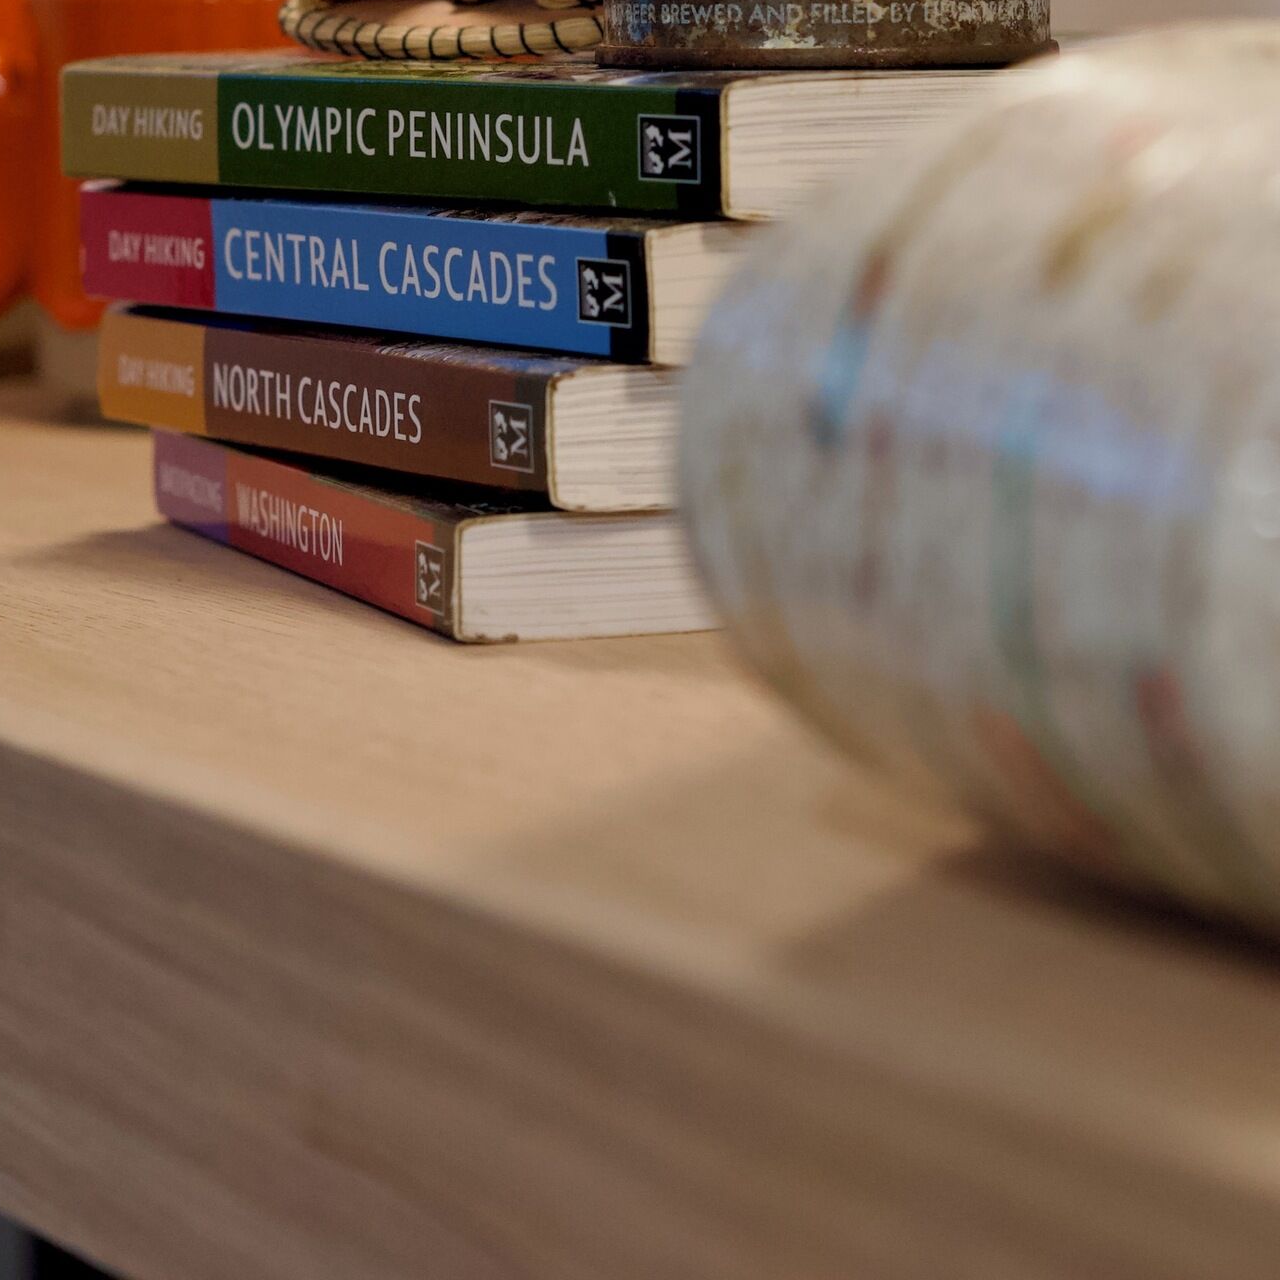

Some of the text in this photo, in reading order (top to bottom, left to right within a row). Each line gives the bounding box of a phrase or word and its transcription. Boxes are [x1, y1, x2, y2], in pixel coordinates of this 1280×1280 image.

[660, 2, 743, 25] BREWED
[747, 2, 804, 25] AND
[810, 1, 882, 25] FILLED
[889, 1, 916, 25] BY
[91, 101, 204, 141] DAY HIKING
[231, 101, 590, 168] OLYMPIC PENINSULA
[107, 229, 206, 270] DAY HIKING
[223, 227, 558, 312] CENTRAL CASCADES
[212, 361, 422, 445] NORTH CASCADES
[235, 480, 344, 568] WASHINGTON
